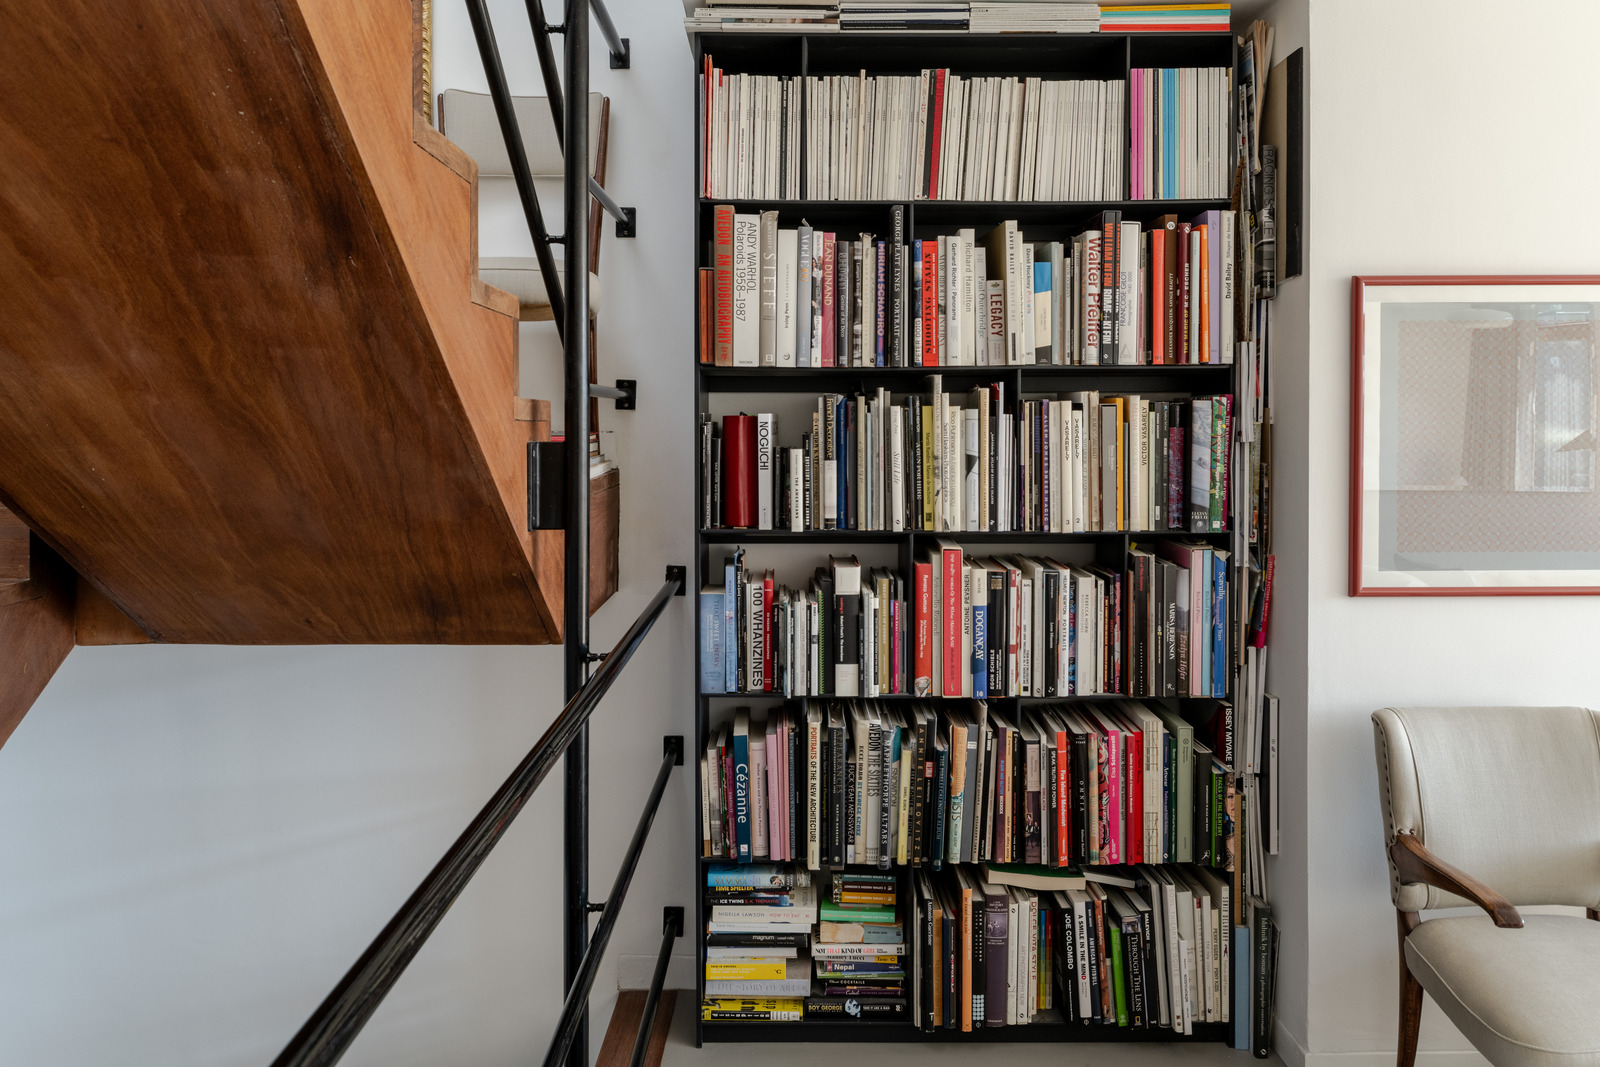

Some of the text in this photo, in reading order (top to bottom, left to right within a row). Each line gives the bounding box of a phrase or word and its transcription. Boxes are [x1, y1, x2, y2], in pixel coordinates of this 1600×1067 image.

[1263, 149, 1274, 235] RACING STYLE
[736, 221, 746, 265] Polaroids
[747, 222, 757, 294] ANDY WARHOL
[717, 210, 732, 344] AVEDON AN AUTOBIOGRAPHY
[824, 238, 834, 306] JEAN DUNAND
[877, 243, 885, 336] MIRIAM SCHAPIRO
[1088, 237, 1101, 348] Walter Pfeiffer
[1119, 271, 1127, 327] FRANÇOISE GILOT
[924, 252, 932, 354] SHOOTING STALIN
[977, 293, 986, 339] Outerbridge
[990, 294, 1003, 337] LEGACY
[759, 421, 769, 470] NOGUCHI
[752, 585, 762, 687] 100 WHANZINES
[973, 610, 984, 661] DOGANÇAY
[1177, 634, 1188, 680] Evelyn Hofer
[810, 727, 818, 760] PORTRAITS
[810, 761, 817, 769] OF
[868, 723, 881, 797] AVEDON THE SIXTIES
[735, 763, 749, 824] Cézanne
[882, 739, 891, 808] MAPPLETHORPE
[1051, 783, 1057, 791] TO
[809, 798, 817, 843] ARCHITECTURE
[914, 777, 923, 850] LEIBOVITZ
[1065, 913, 1074, 970] JOE COLOMBO
[1131, 934, 1139, 975] THROUGH
[1133, 975, 1141, 993] THE
